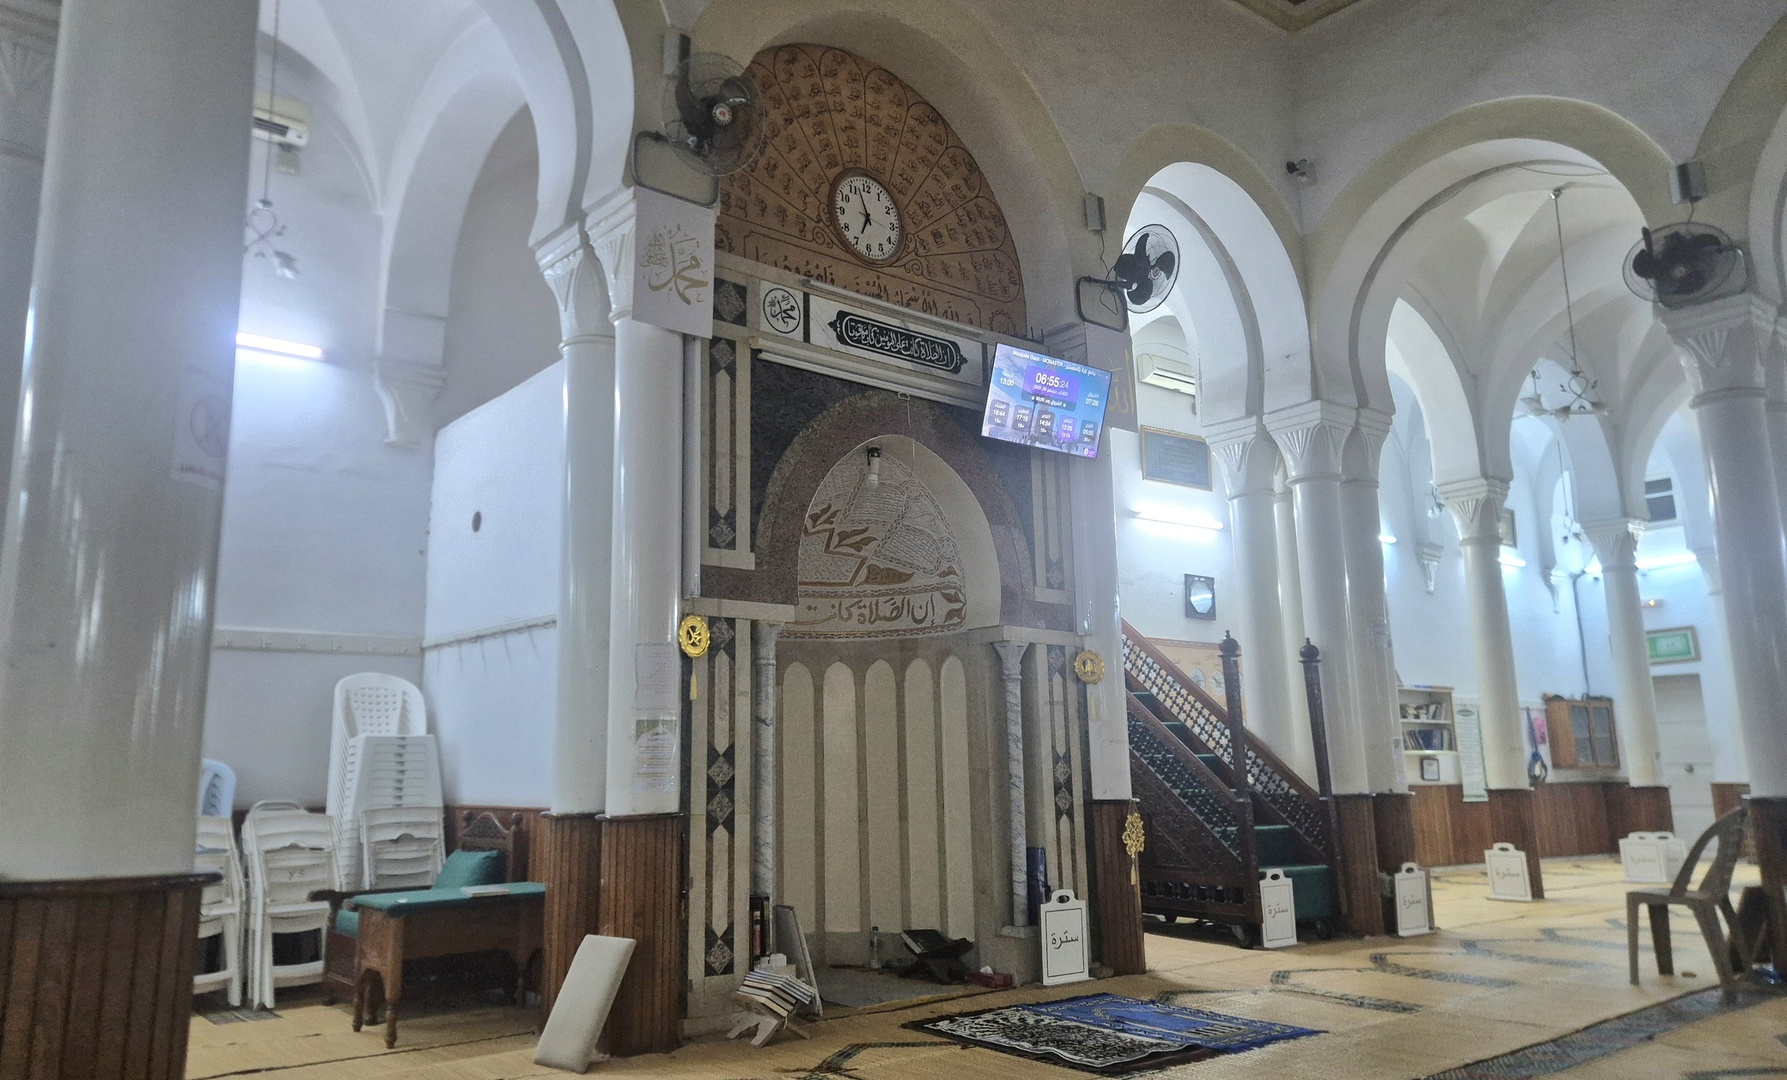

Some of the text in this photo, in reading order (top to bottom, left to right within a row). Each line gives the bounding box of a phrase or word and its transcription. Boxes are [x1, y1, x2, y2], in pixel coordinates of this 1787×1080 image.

[849, 184, 857, 194] 11
[862, 184, 872, 194] 12
[840, 190, 850, 203] 10
[877, 192, 880, 202] 1
[840, 206, 845, 216] 9
[884, 206, 890, 215] 2
[844, 222, 850, 232] 8
[890, 222, 895, 232] 3
[854, 236, 859, 246] 7
[886, 236, 892, 244] 4
[866, 244, 872, 252] 6
[878, 243, 884, 252] 5
[1042, 357, 1064, 367] MONASTIR
[1000, 377, 1015, 387] 13:00
[857, 596, 911, 626] الصلاة
[1267, 902, 1289, 918] سترة
[1051, 930, 1079, 950] سترة
